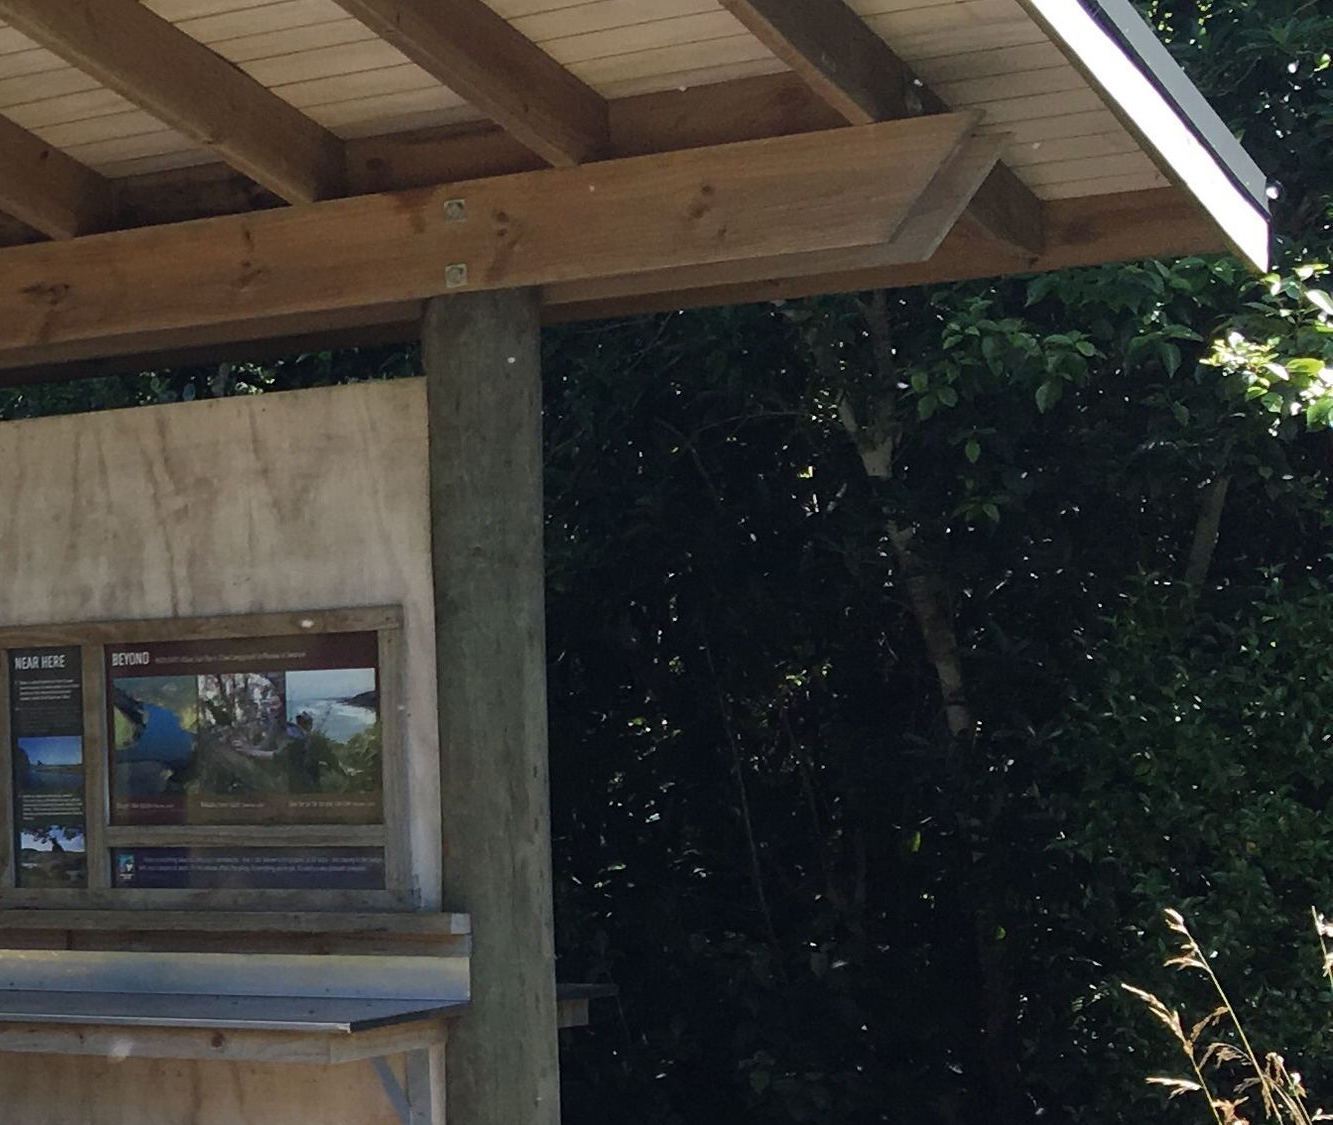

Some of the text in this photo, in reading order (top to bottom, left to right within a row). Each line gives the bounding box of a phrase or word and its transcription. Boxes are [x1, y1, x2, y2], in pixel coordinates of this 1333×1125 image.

[14, 654, 66, 670] NEAR HERE
[111, 651, 150, 666] BEYOND
